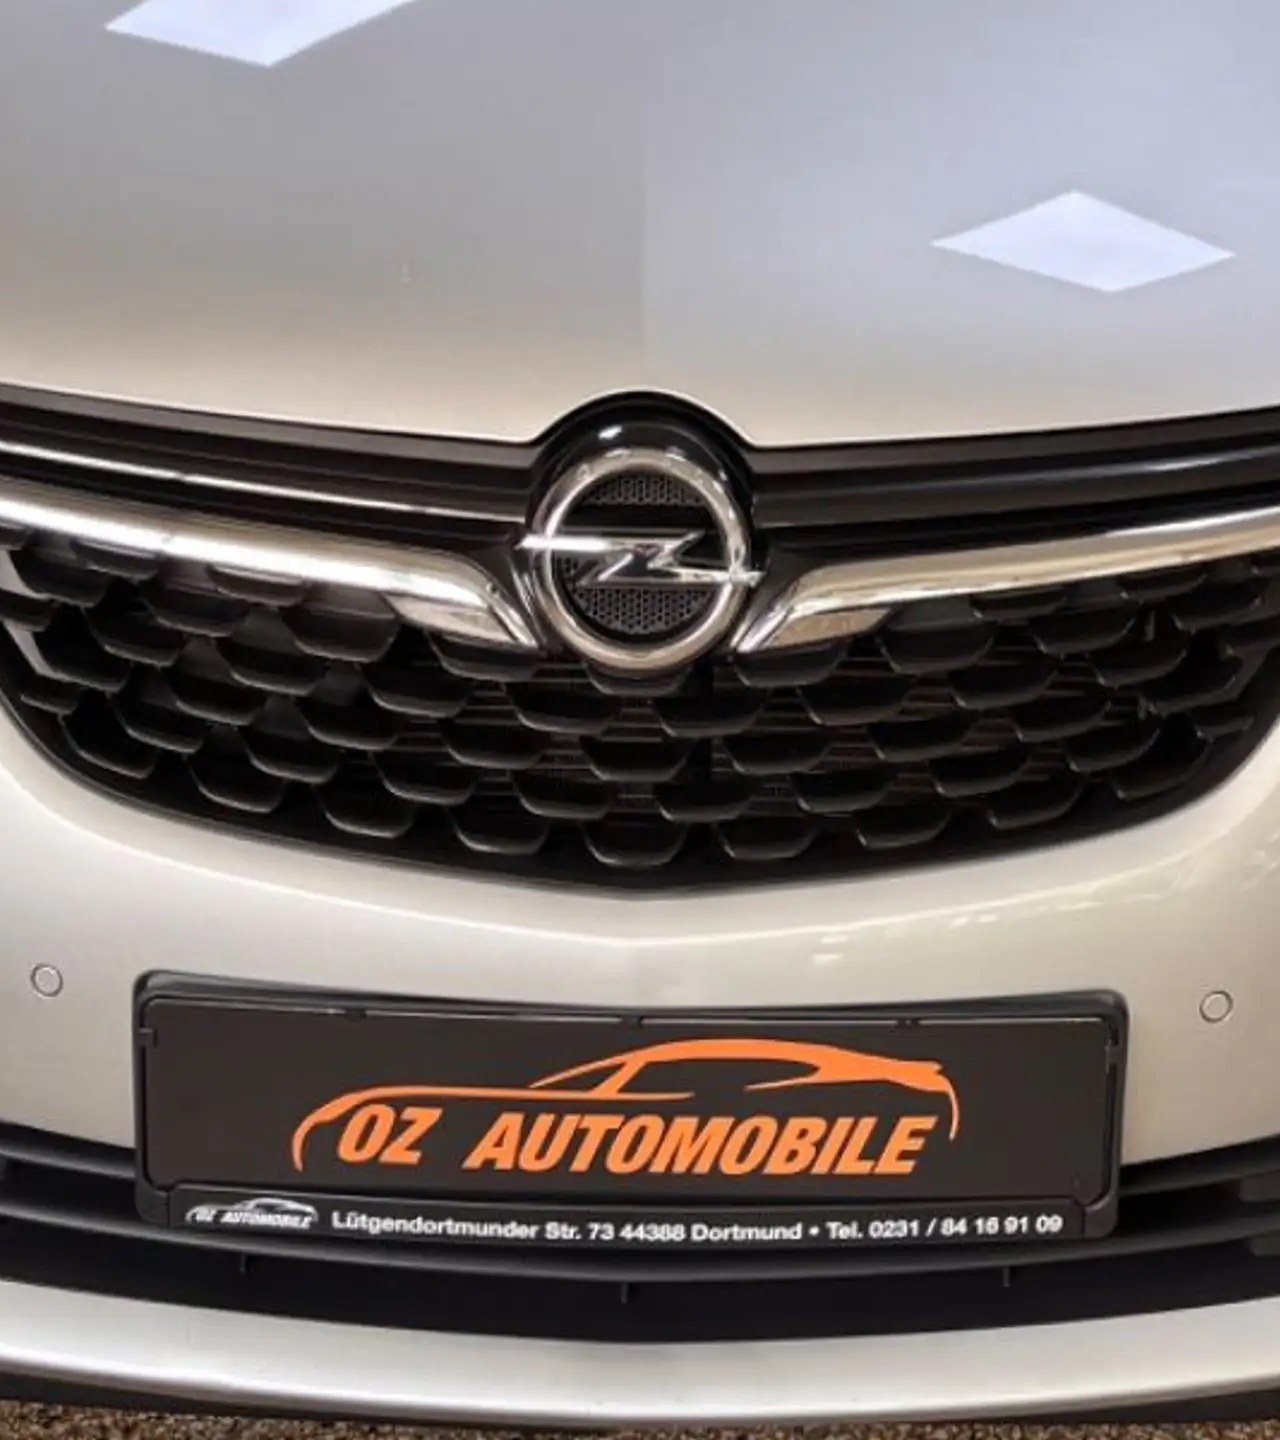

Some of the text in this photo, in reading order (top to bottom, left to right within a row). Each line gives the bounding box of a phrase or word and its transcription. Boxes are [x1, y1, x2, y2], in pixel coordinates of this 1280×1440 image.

[337, 1104, 939, 1176] OZ AUTOMOBILE
[331, 1210, 540, 1240] Lütgendortmunder
[544, 1221, 582, 1241] Str.
[588, 1222, 615, 1241] 73
[618, 1223, 687, 1242] 44388
[690, 1222, 803, 1242] Dortmund
[825, 1221, 864, 1240] Tel.
[868, 1219, 920, 1239] 0231
[939, 1217, 968, 1237] 84
[1003, 1216, 1029, 1234] 91
[1035, 1214, 1063, 1234] 09
